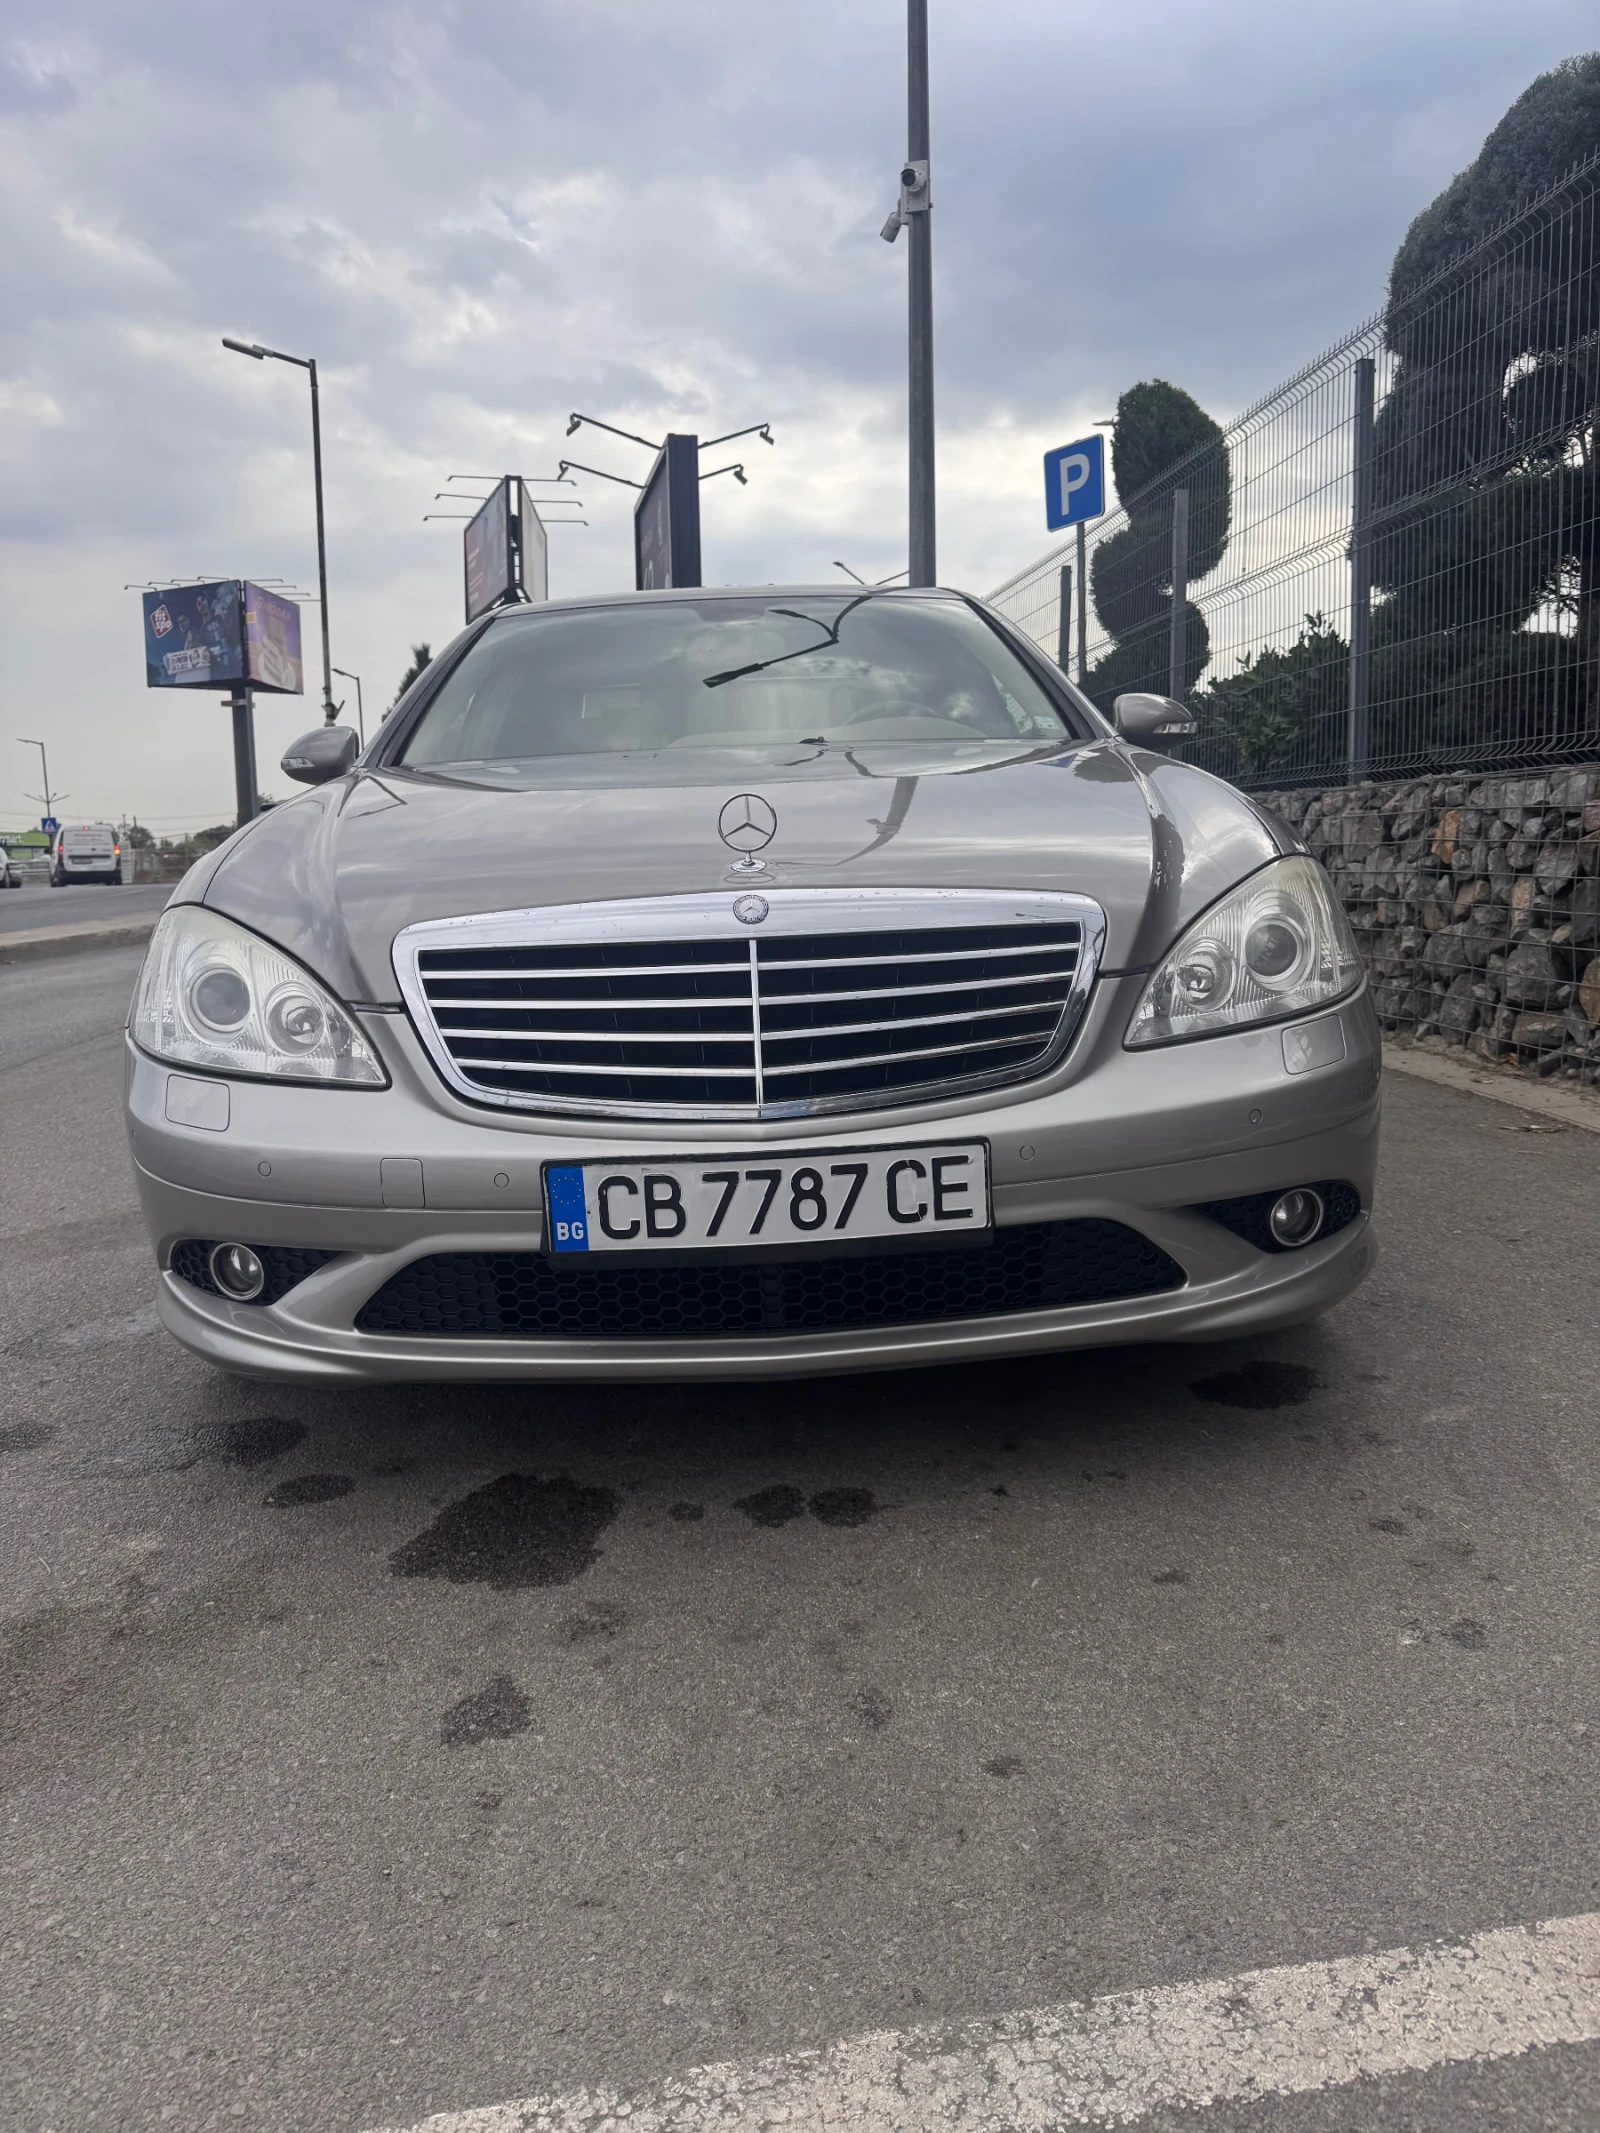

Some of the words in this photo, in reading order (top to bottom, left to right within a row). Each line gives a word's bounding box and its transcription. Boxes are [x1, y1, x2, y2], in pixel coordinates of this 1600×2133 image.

[1060, 453, 1090, 516] P
[597, 1174, 687, 1240] CB
[701, 1163, 868, 1237] 7787
[886, 1155, 974, 1223] CE
[556, 1221, 584, 1241] BG
